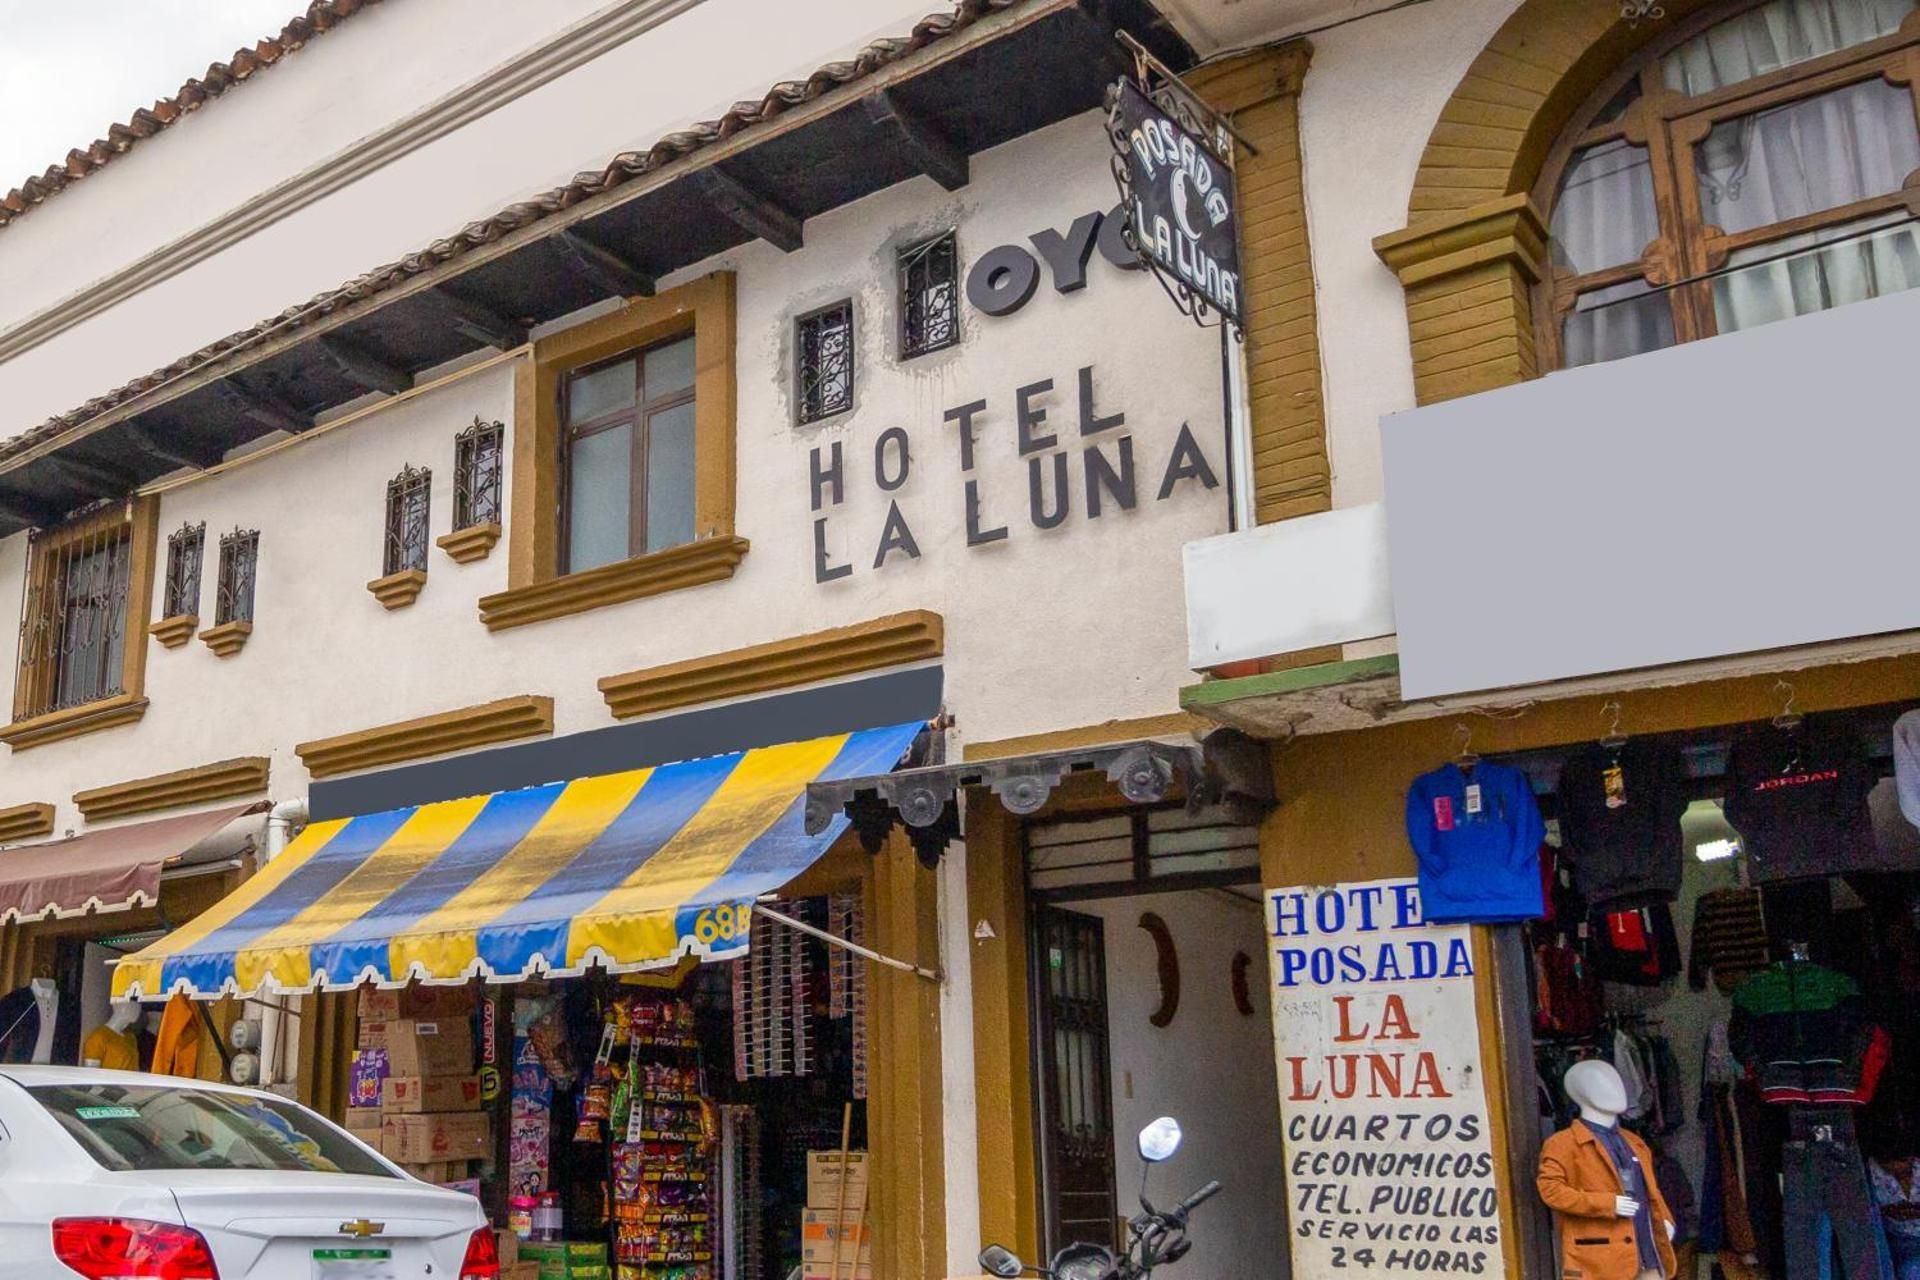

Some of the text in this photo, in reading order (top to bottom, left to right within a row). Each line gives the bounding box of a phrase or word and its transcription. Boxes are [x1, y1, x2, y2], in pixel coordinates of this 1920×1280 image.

[1131, 117, 1230, 229] POSADA
[1134, 193, 1172, 267] LA
[809, 364, 1125, 512] HOTEL
[813, 422, 1220, 584] LA LUNA
[1753, 770, 1838, 791] JORDAN
[1271, 884, 1468, 937] HOTE
[1276, 938, 1475, 987] POSADA
[483, 1002, 494, 1059] NUEVO
[1333, 994, 1421, 1042] LA
[1285, 1051, 1453, 1101] LUNA
[1288, 1114, 1480, 1142] CUARTOS
[1291, 1151, 1493, 1178] ECONOMICOS
[1297, 1184, 1498, 1218] TEL. PUBLICO
[1296, 1219, 1499, 1245] SERVICIO LAS
[1331, 1246, 1488, 1275] 24 HORAS
